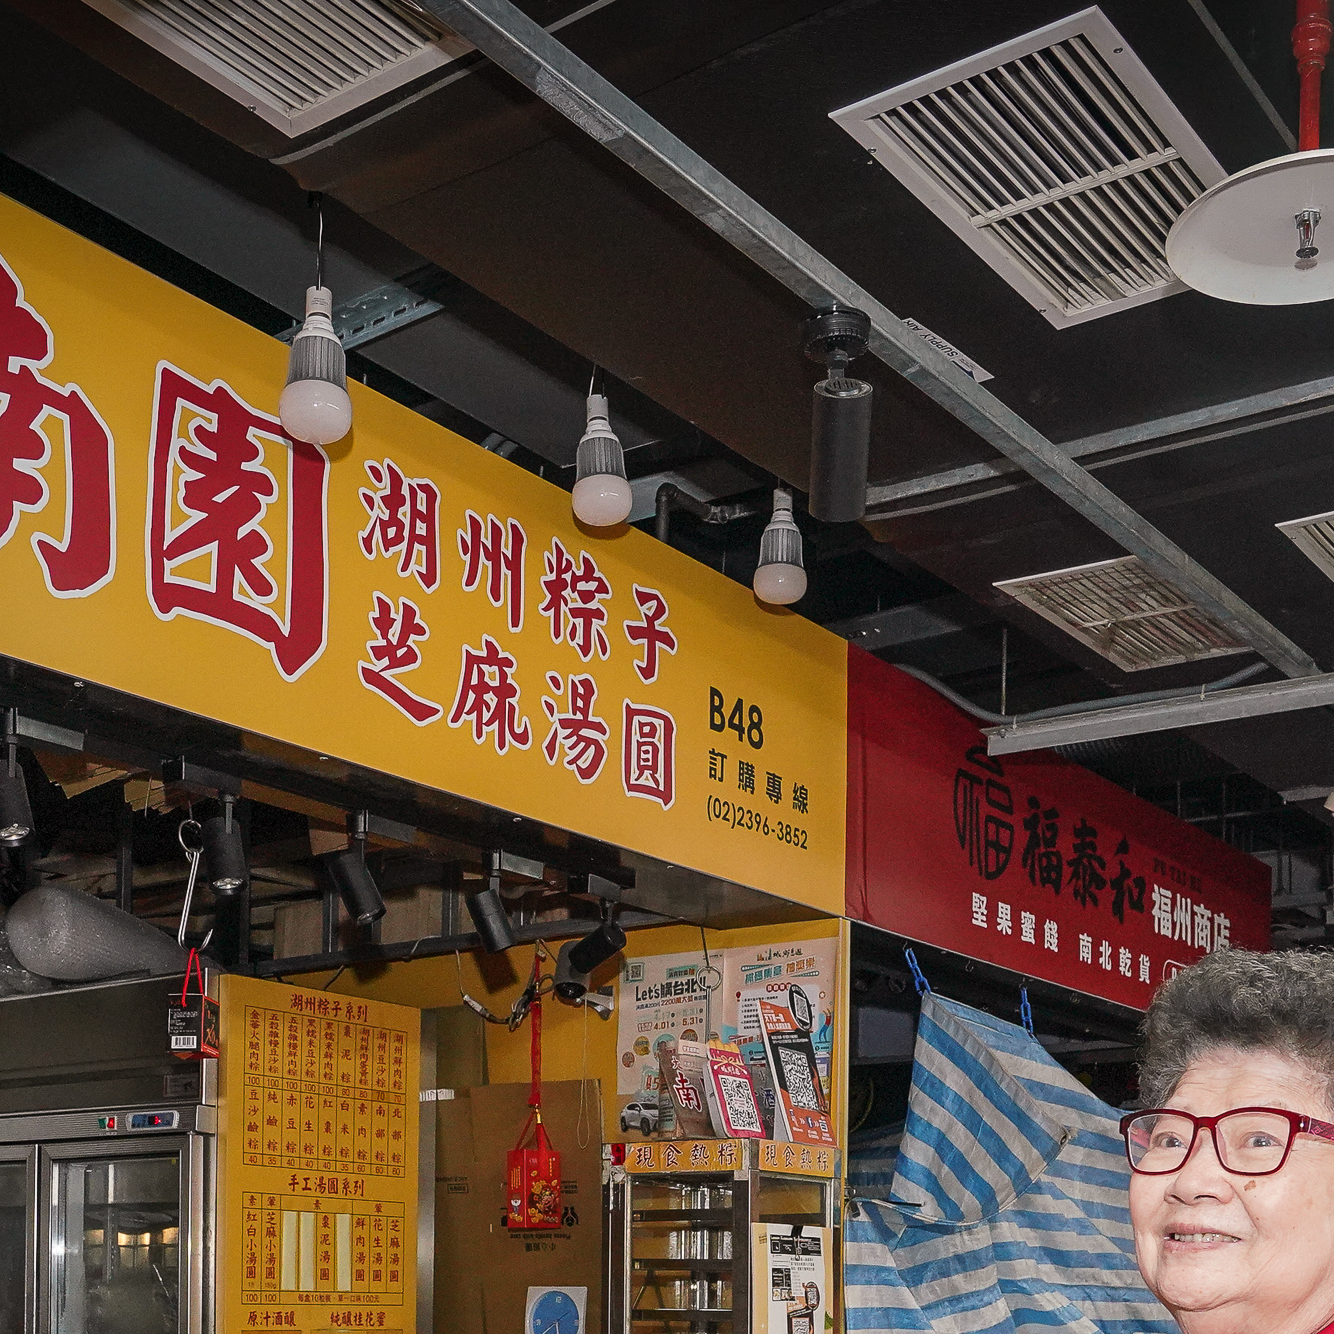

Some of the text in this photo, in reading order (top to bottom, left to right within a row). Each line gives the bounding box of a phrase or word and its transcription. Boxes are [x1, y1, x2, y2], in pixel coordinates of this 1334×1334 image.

[358, 458, 678, 685] 湖州粽子
[356, 591, 677, 810] 芝麻湯圓
[708, 685, 765, 753] B48
[707, 748, 810, 816] 訂購專線
[706, 797, 810, 852] (02)2396-3852
[1022, 796, 1145, 924] 福泰和
[971, 892, 1152, 985] 堅果蜜餞 南北乾貨
[1151, 884, 1232, 955] 福州商店
[290, 993, 369, 1023] 湖州粽子系列
[247, 1076, 260, 1086] 100
[267, 1078, 280, 1088] 100
[285, 1081, 298, 1091] 100
[304, 1083, 316, 1093] 100
[322, 1085, 334, 1095] 100
[376, 1091, 386, 1101] 70
[285, 1093, 298, 1153] 赤豆粽
[303, 1095, 315, 1155] 花生粽
[340, 1100, 350, 1159] 白米粽
[375, 1103, 385, 1162] 南部粽
[391, 1104, 402, 1164] 北部粽
[248, 1155, 258, 1164] 40
[635, 1143, 737, 1168] 現食熱粽
[765, 1143, 829, 1172] 現食熱粽
[288, 1174, 365, 1197] 手工湯圓系列
[246, 1211, 258, 1279] 紅白小湯圓
[265, 1212, 277, 1280] 芝麻小湯圓
[355, 1217, 366, 1282] 鮮肉湯圓
[372, 1218, 383, 1282] 花生湯圓
[389, 1219, 401, 1283] 芝麻湯圓
[246, 1293, 258, 1302] 100
[247, 1310, 296, 1328] 原汁酒釀
[265, 1294, 277, 1302] 100
[330, 1311, 387, 1328] 純釀桂花蜜
